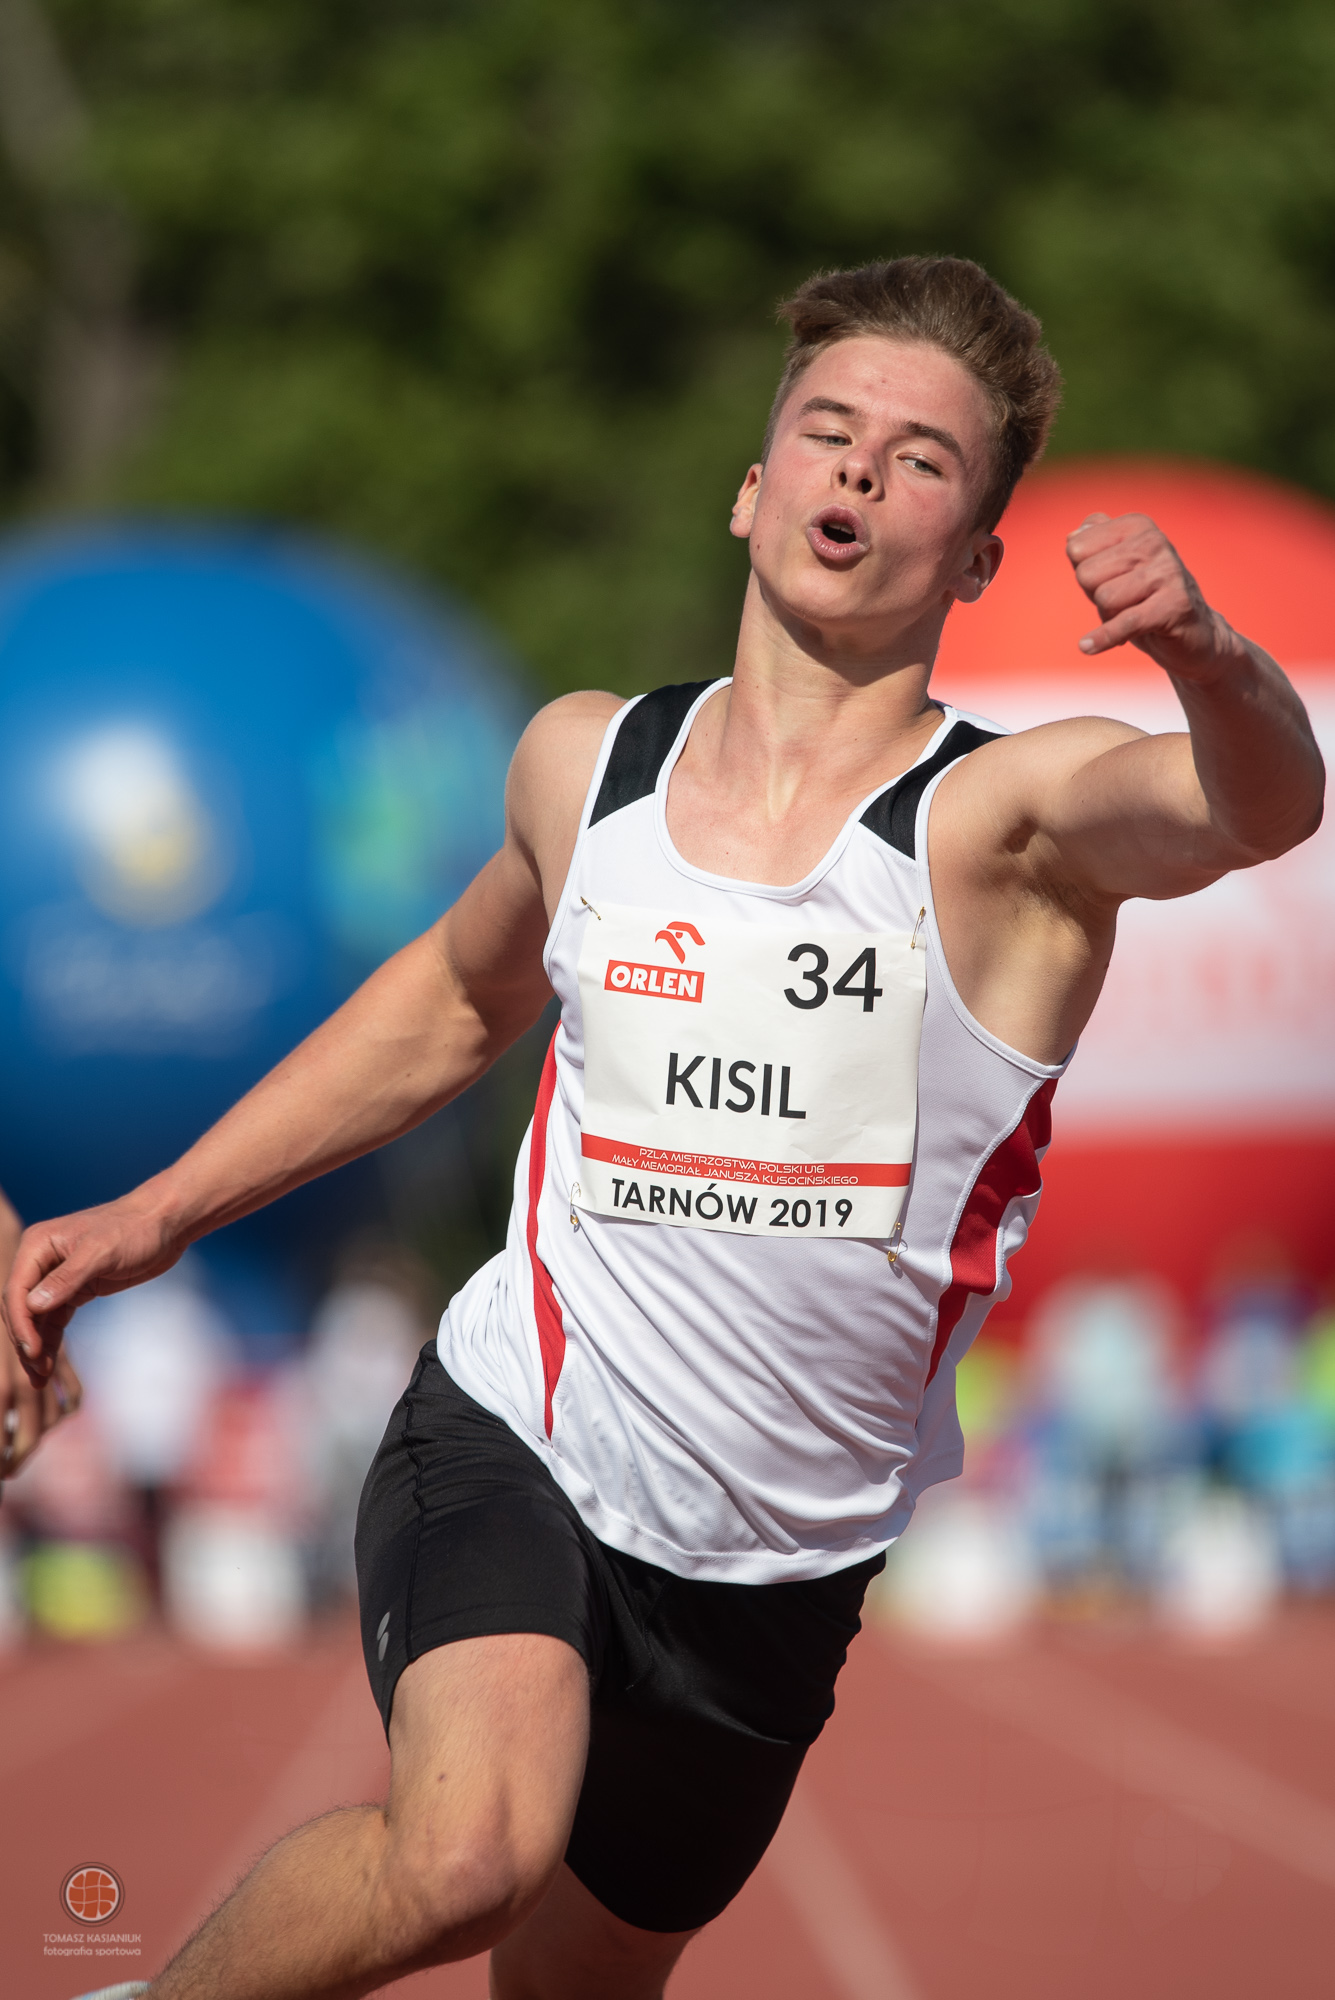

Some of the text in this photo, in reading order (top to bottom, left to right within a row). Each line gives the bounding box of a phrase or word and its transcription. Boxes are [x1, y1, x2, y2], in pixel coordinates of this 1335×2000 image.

[610, 965, 698, 998] ORLEN
[783, 943, 883, 1012] 34
[665, 1052, 807, 1119] KISIL
[611, 1154, 859, 1186] MAŁY MEMORIAŁ JANUSZA KUSOCIŃSKIEGO
[639, 1148, 825, 1174] PZLA MISTRZOSTWA POLSKI U16
[611, 1178, 853, 1228] TARNÓW 2019
